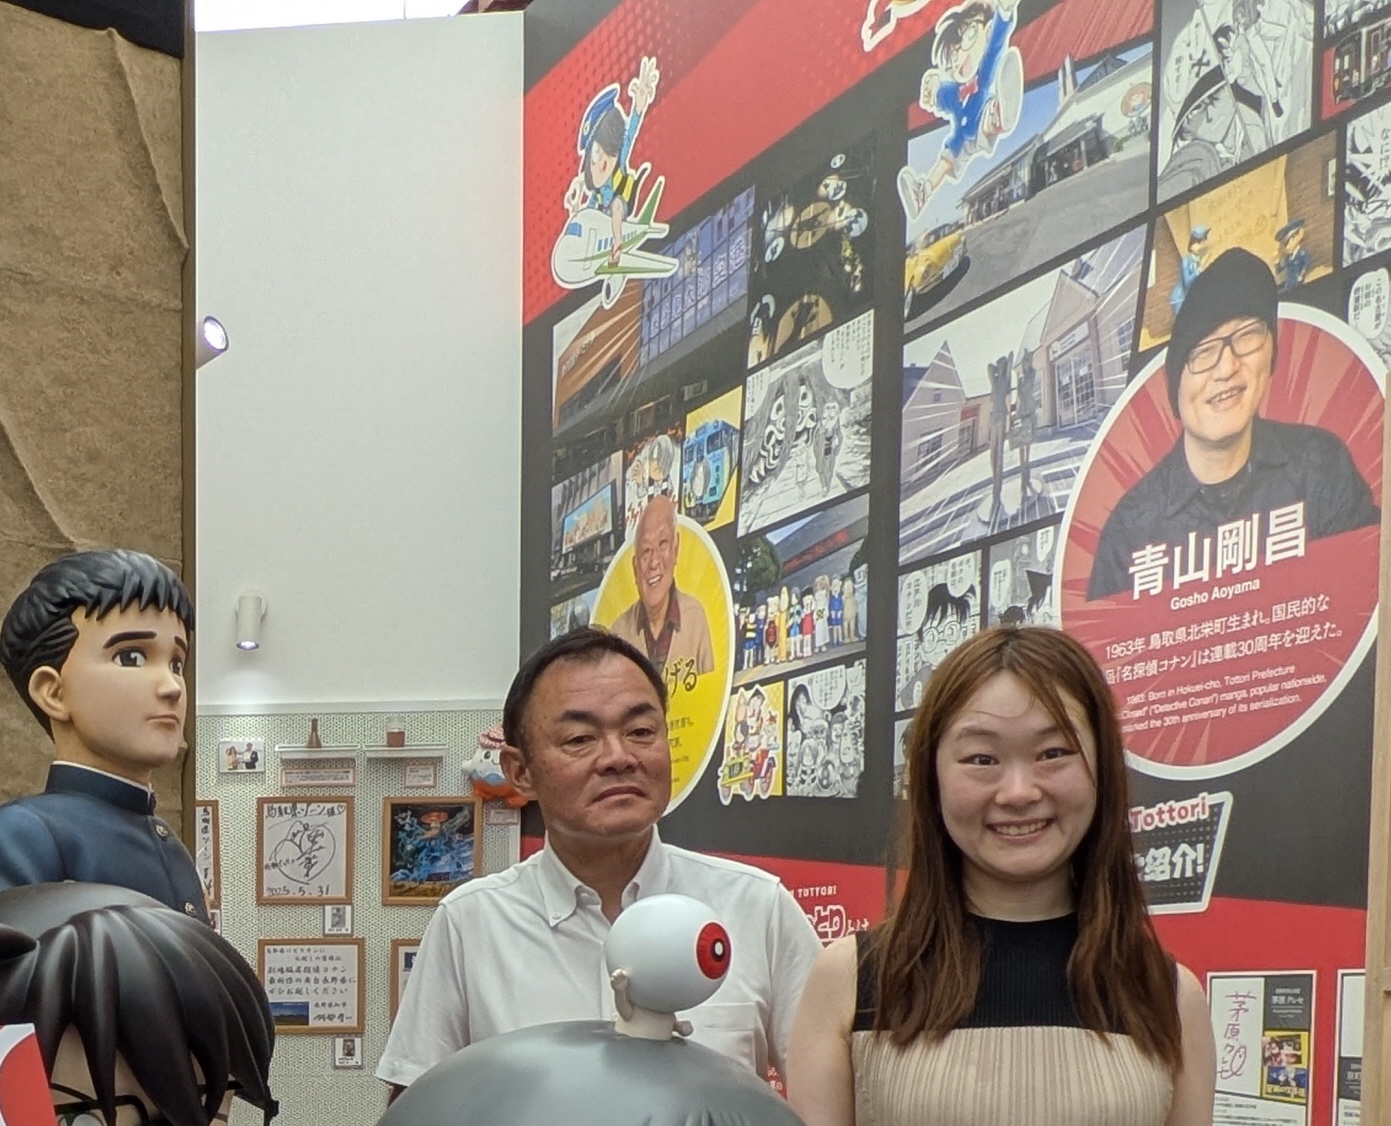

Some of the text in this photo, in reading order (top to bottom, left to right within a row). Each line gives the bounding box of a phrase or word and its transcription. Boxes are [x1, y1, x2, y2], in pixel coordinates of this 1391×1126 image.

[1129, 501, 1307, 599] 青山剛昌
[1170, 579, 1261, 610] Gosho Aoyama
[1106, 593, 1330, 660] 1963年 鳥取県北栄町生まれ。国民的な
[1148, 690, 1167, 701] Born
[1251, 664, 1296, 681] Prefecture
[1249, 682, 1280, 698] popular
[1149, 718, 1162, 730] the
[1181, 707, 1228, 724] anniversary
[1227, 703, 1237, 715] of
[1237, 702, 1249, 713] its
[1249, 693, 1302, 712] serialization.
[1130, 793, 1208, 832] Tottori
